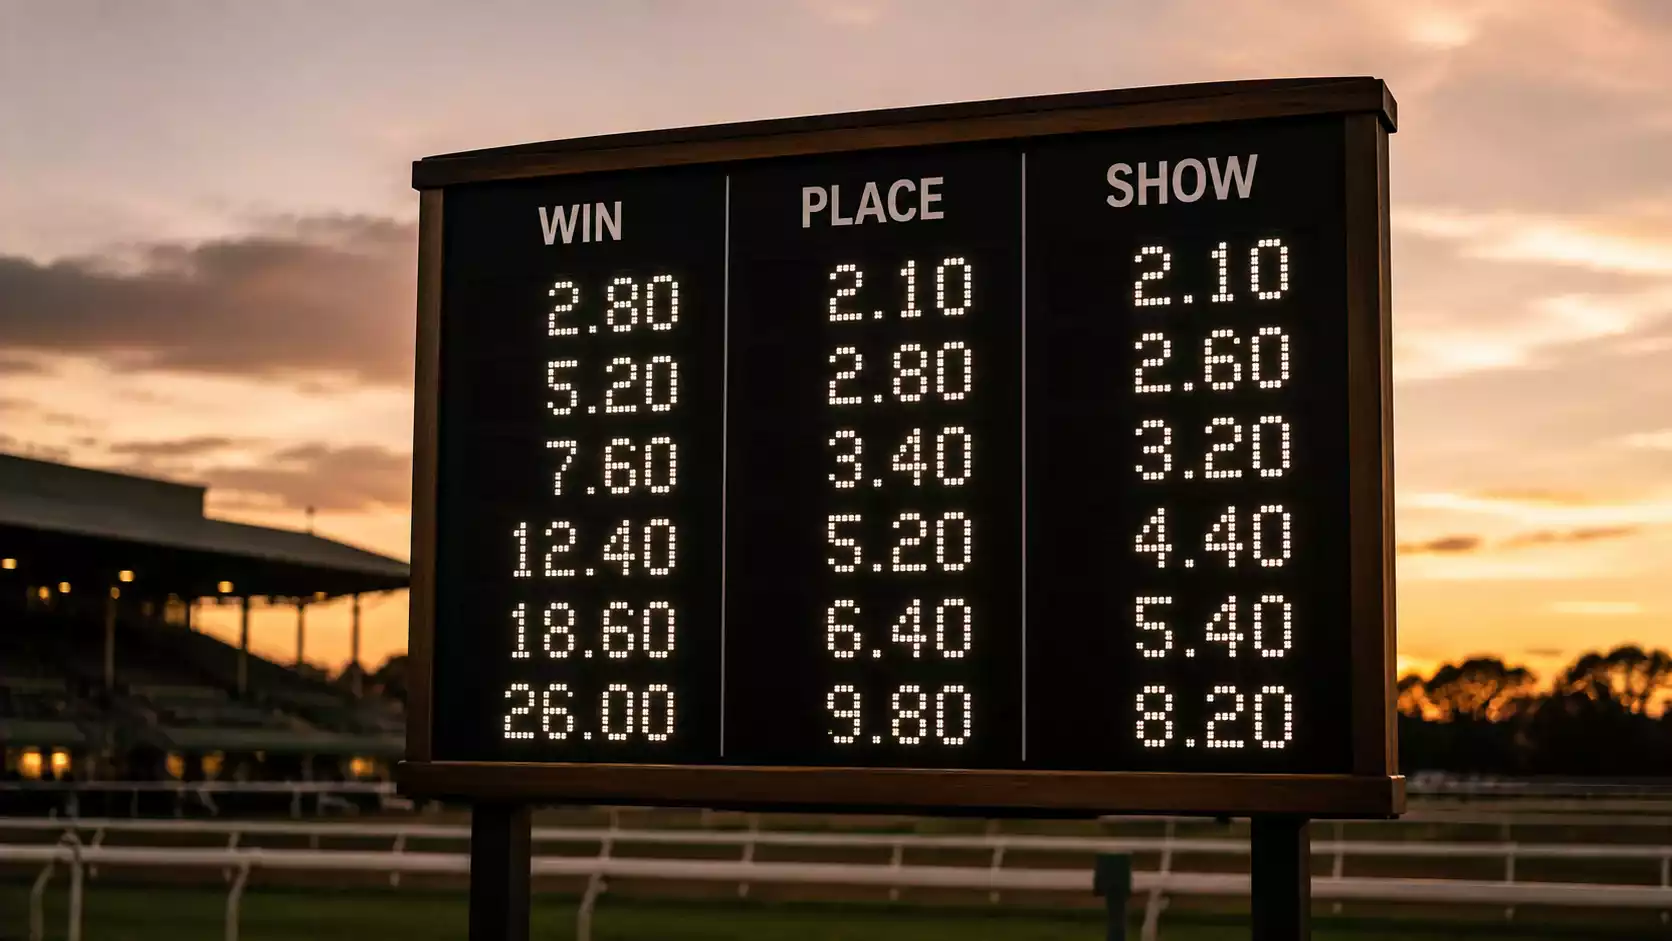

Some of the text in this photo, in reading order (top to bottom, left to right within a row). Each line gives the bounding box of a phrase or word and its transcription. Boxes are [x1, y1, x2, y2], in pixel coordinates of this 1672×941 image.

[802, 176, 944, 228] PLACE
[1106, 154, 1258, 208] SHOW
[538, 201, 622, 246] WIN
[829, 256, 972, 322] 2.10
[1134, 238, 1289, 307] 2.10
[548, 274, 679, 337] 2.80
[547, 355, 678, 416] 5.20
[828, 341, 972, 405] 2.80
[1134, 326, 1290, 394] 2.60
[546, 436, 677, 496] 7.60
[828, 426, 972, 489] 3.40
[1135, 415, 1291, 481] 3.20
[513, 518, 676, 578] 12.40
[827, 511, 972, 573] 5.20
[1135, 504, 1291, 569] 4.40
[511, 600, 675, 659] 18.60
[827, 598, 972, 659] 6.40
[1135, 594, 1292, 658] 5.40
[504, 683, 674, 742] 26.00
[826, 684, 972, 745] 9.80
[1135, 685, 1293, 749] 8.20
